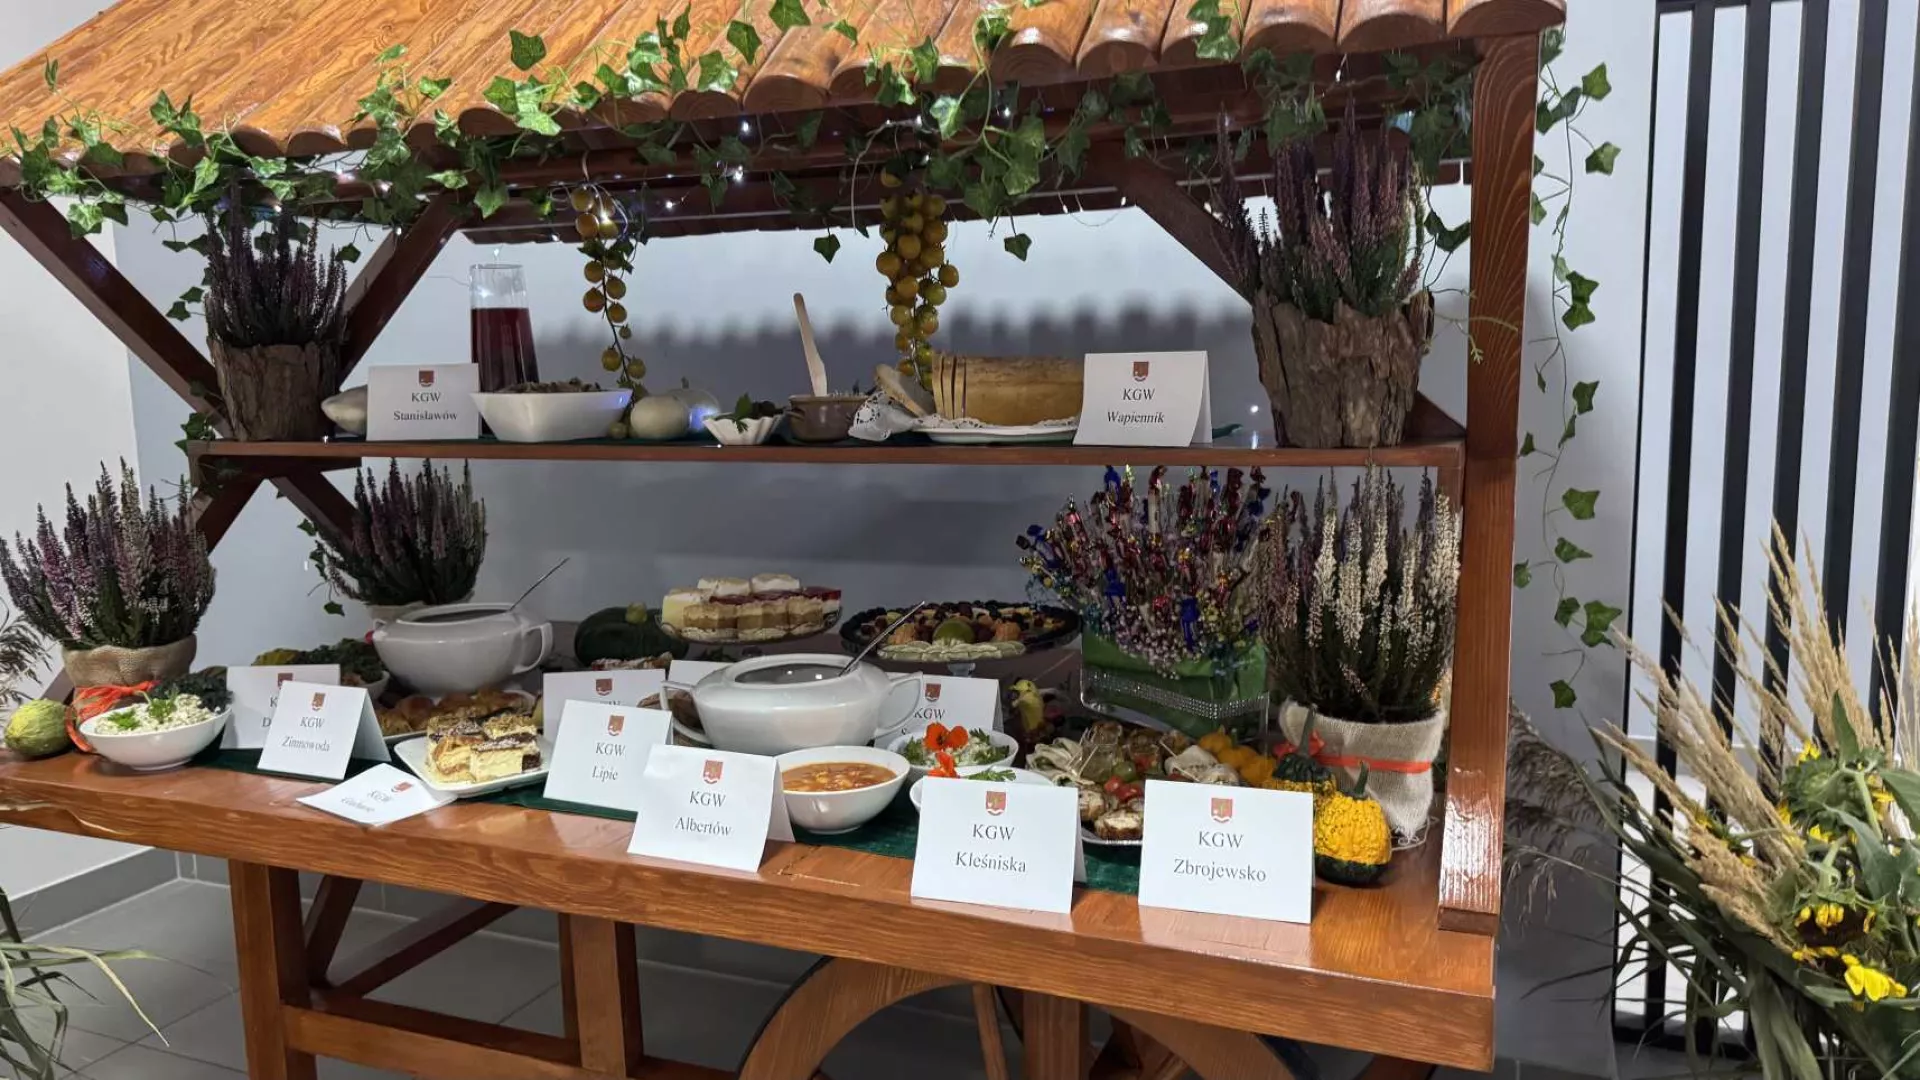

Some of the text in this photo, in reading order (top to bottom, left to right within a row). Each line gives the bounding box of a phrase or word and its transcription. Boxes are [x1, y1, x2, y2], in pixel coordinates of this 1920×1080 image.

[411, 392, 441, 403] KGW
[1122, 388, 1156, 401] KGW
[393, 410, 458, 421] Stanisławów
[1107, 411, 1165, 426] Wapiennik
[914, 708, 945, 720] KGW
[300, 716, 326, 729] KGW
[282, 735, 331, 752] Zimnowoda
[595, 742, 626, 757] KGW
[592, 766, 619, 783] Lipie
[690, 791, 726, 807] KGW
[675, 816, 732, 836] Albertów
[972, 823, 1015, 841] KGW
[1199, 831, 1243, 848] KGW
[955, 851, 1027, 873] Kleśniska
[1173, 858, 1266, 882] Zbrojewsko
